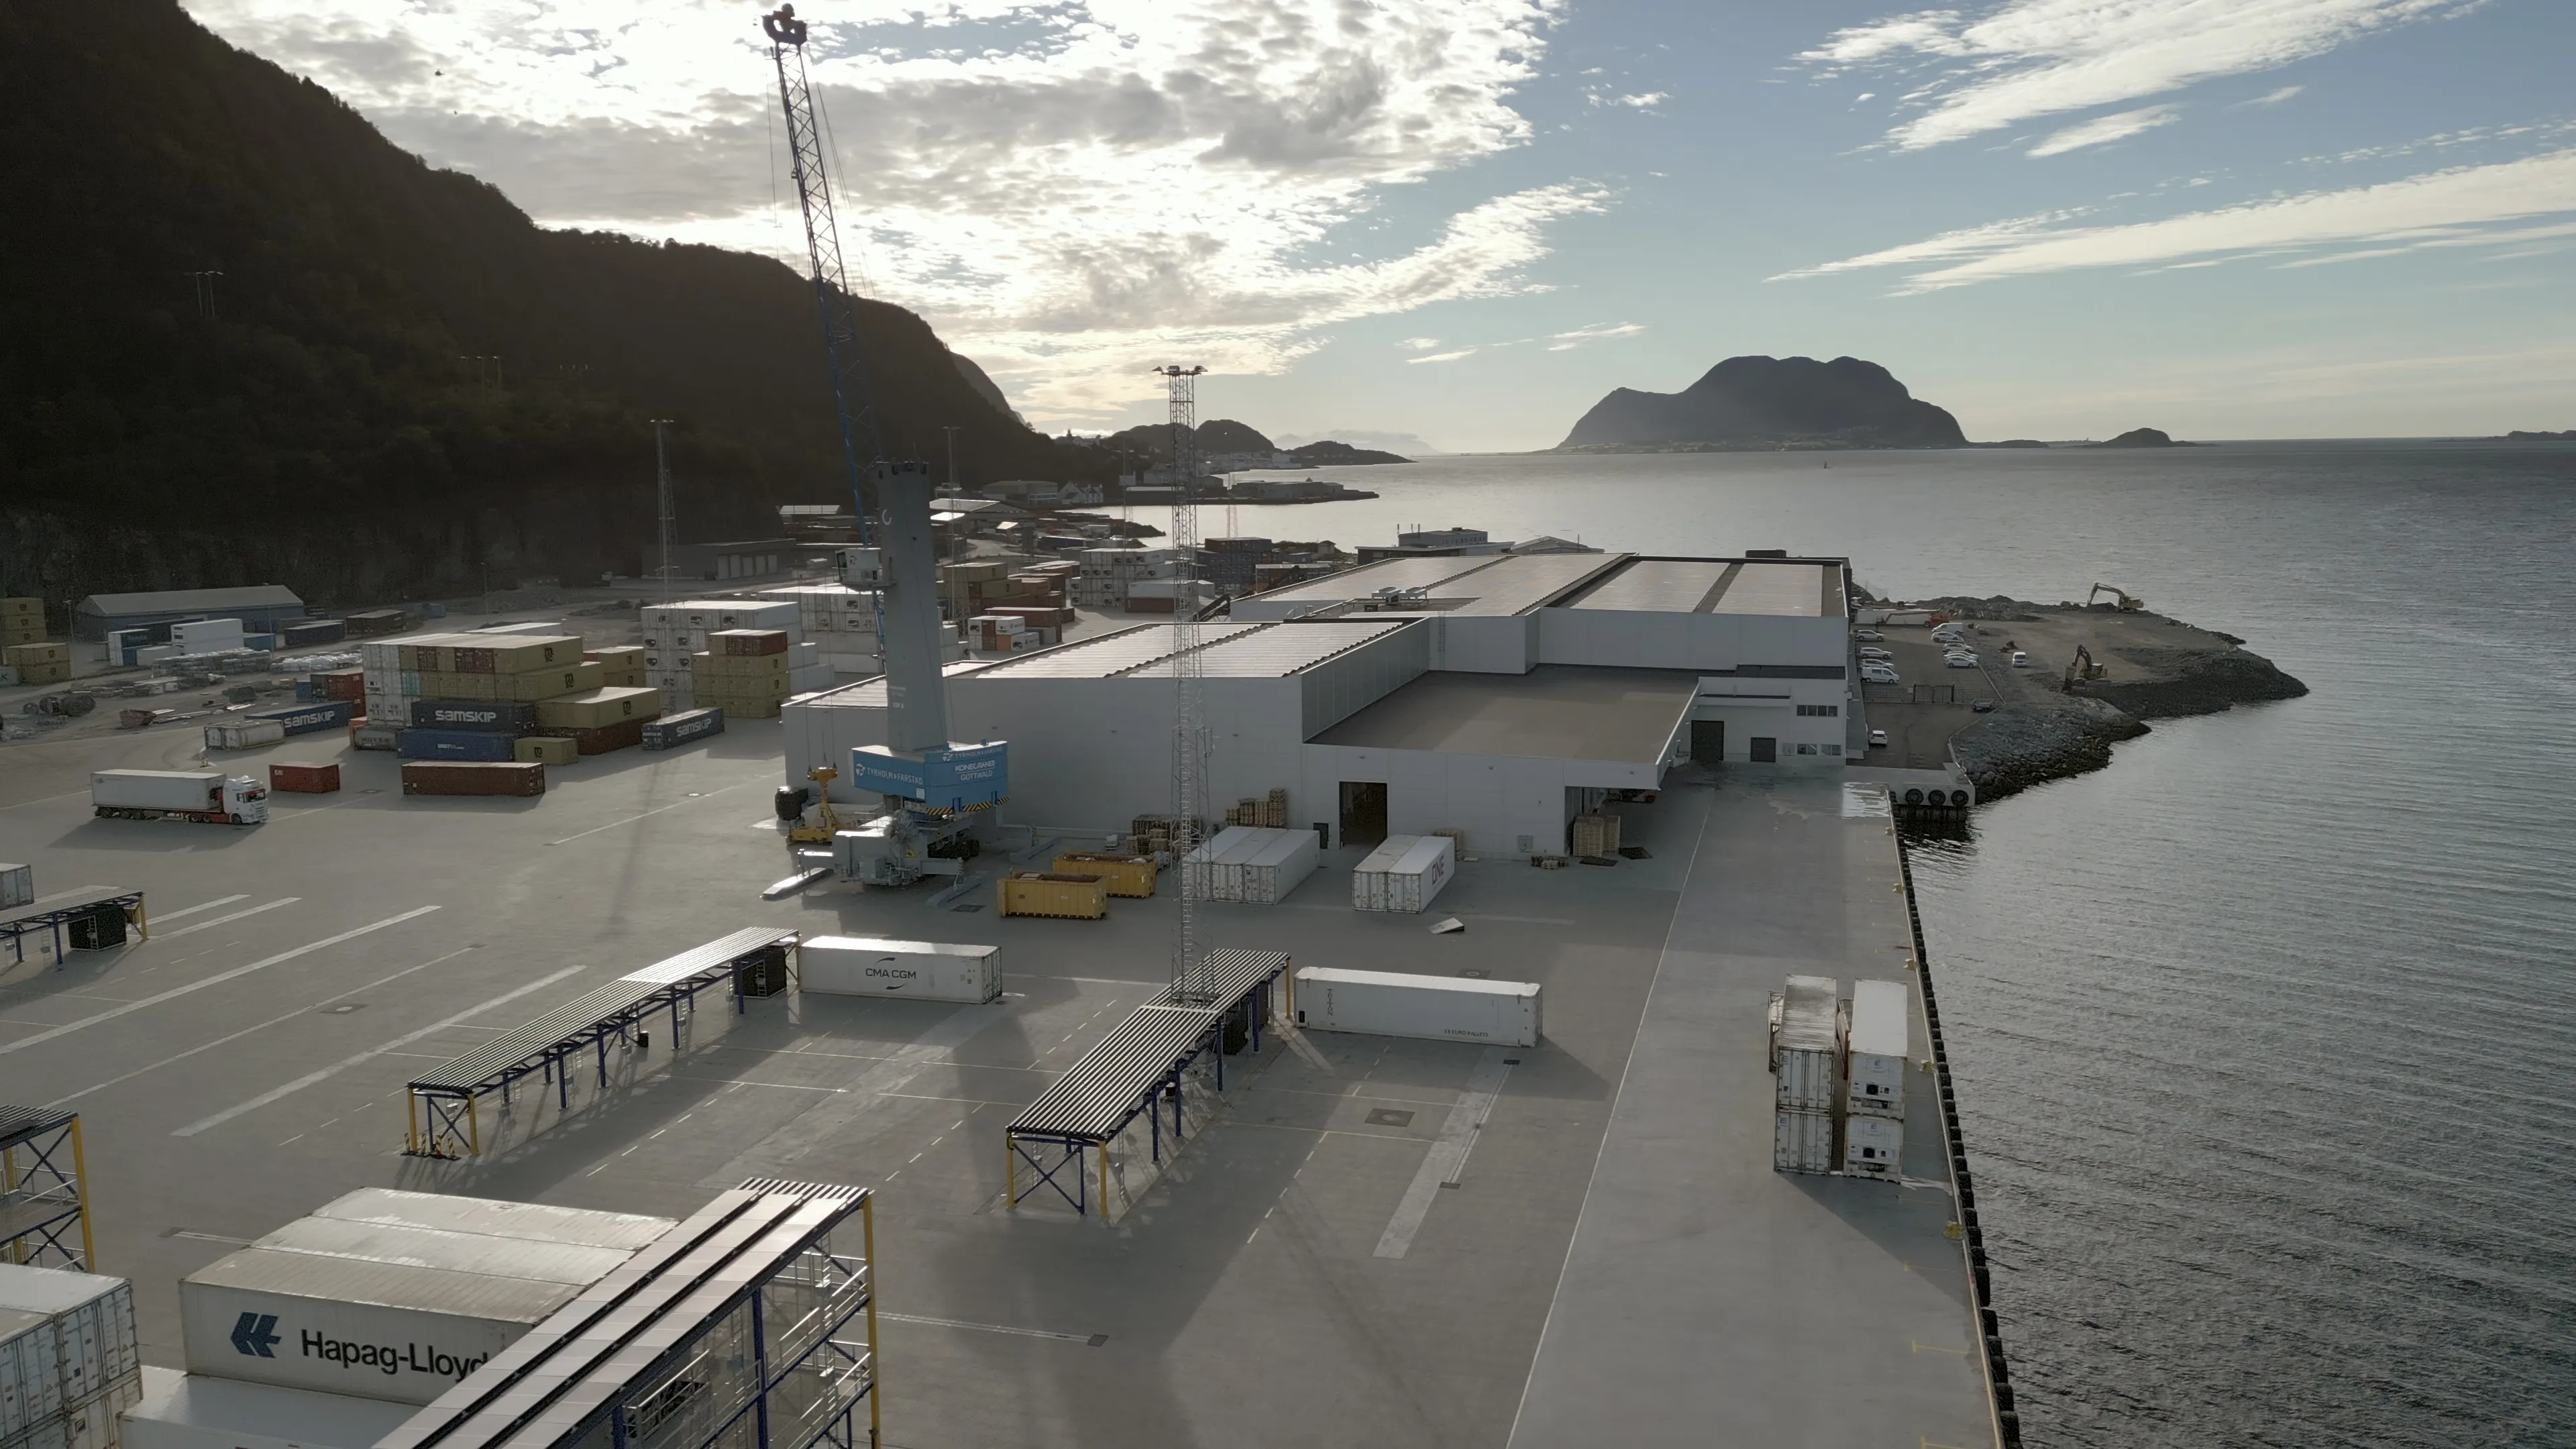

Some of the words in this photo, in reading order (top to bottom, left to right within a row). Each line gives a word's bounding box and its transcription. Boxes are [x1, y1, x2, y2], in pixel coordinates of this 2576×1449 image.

[955, 759, 996, 772] KONECRANES
[897, 773, 923, 785] FARSTAD
[961, 770, 993, 781] GOTTWALD
[865, 968, 890, 977] CMA
[892, 969, 916, 979] CGM
